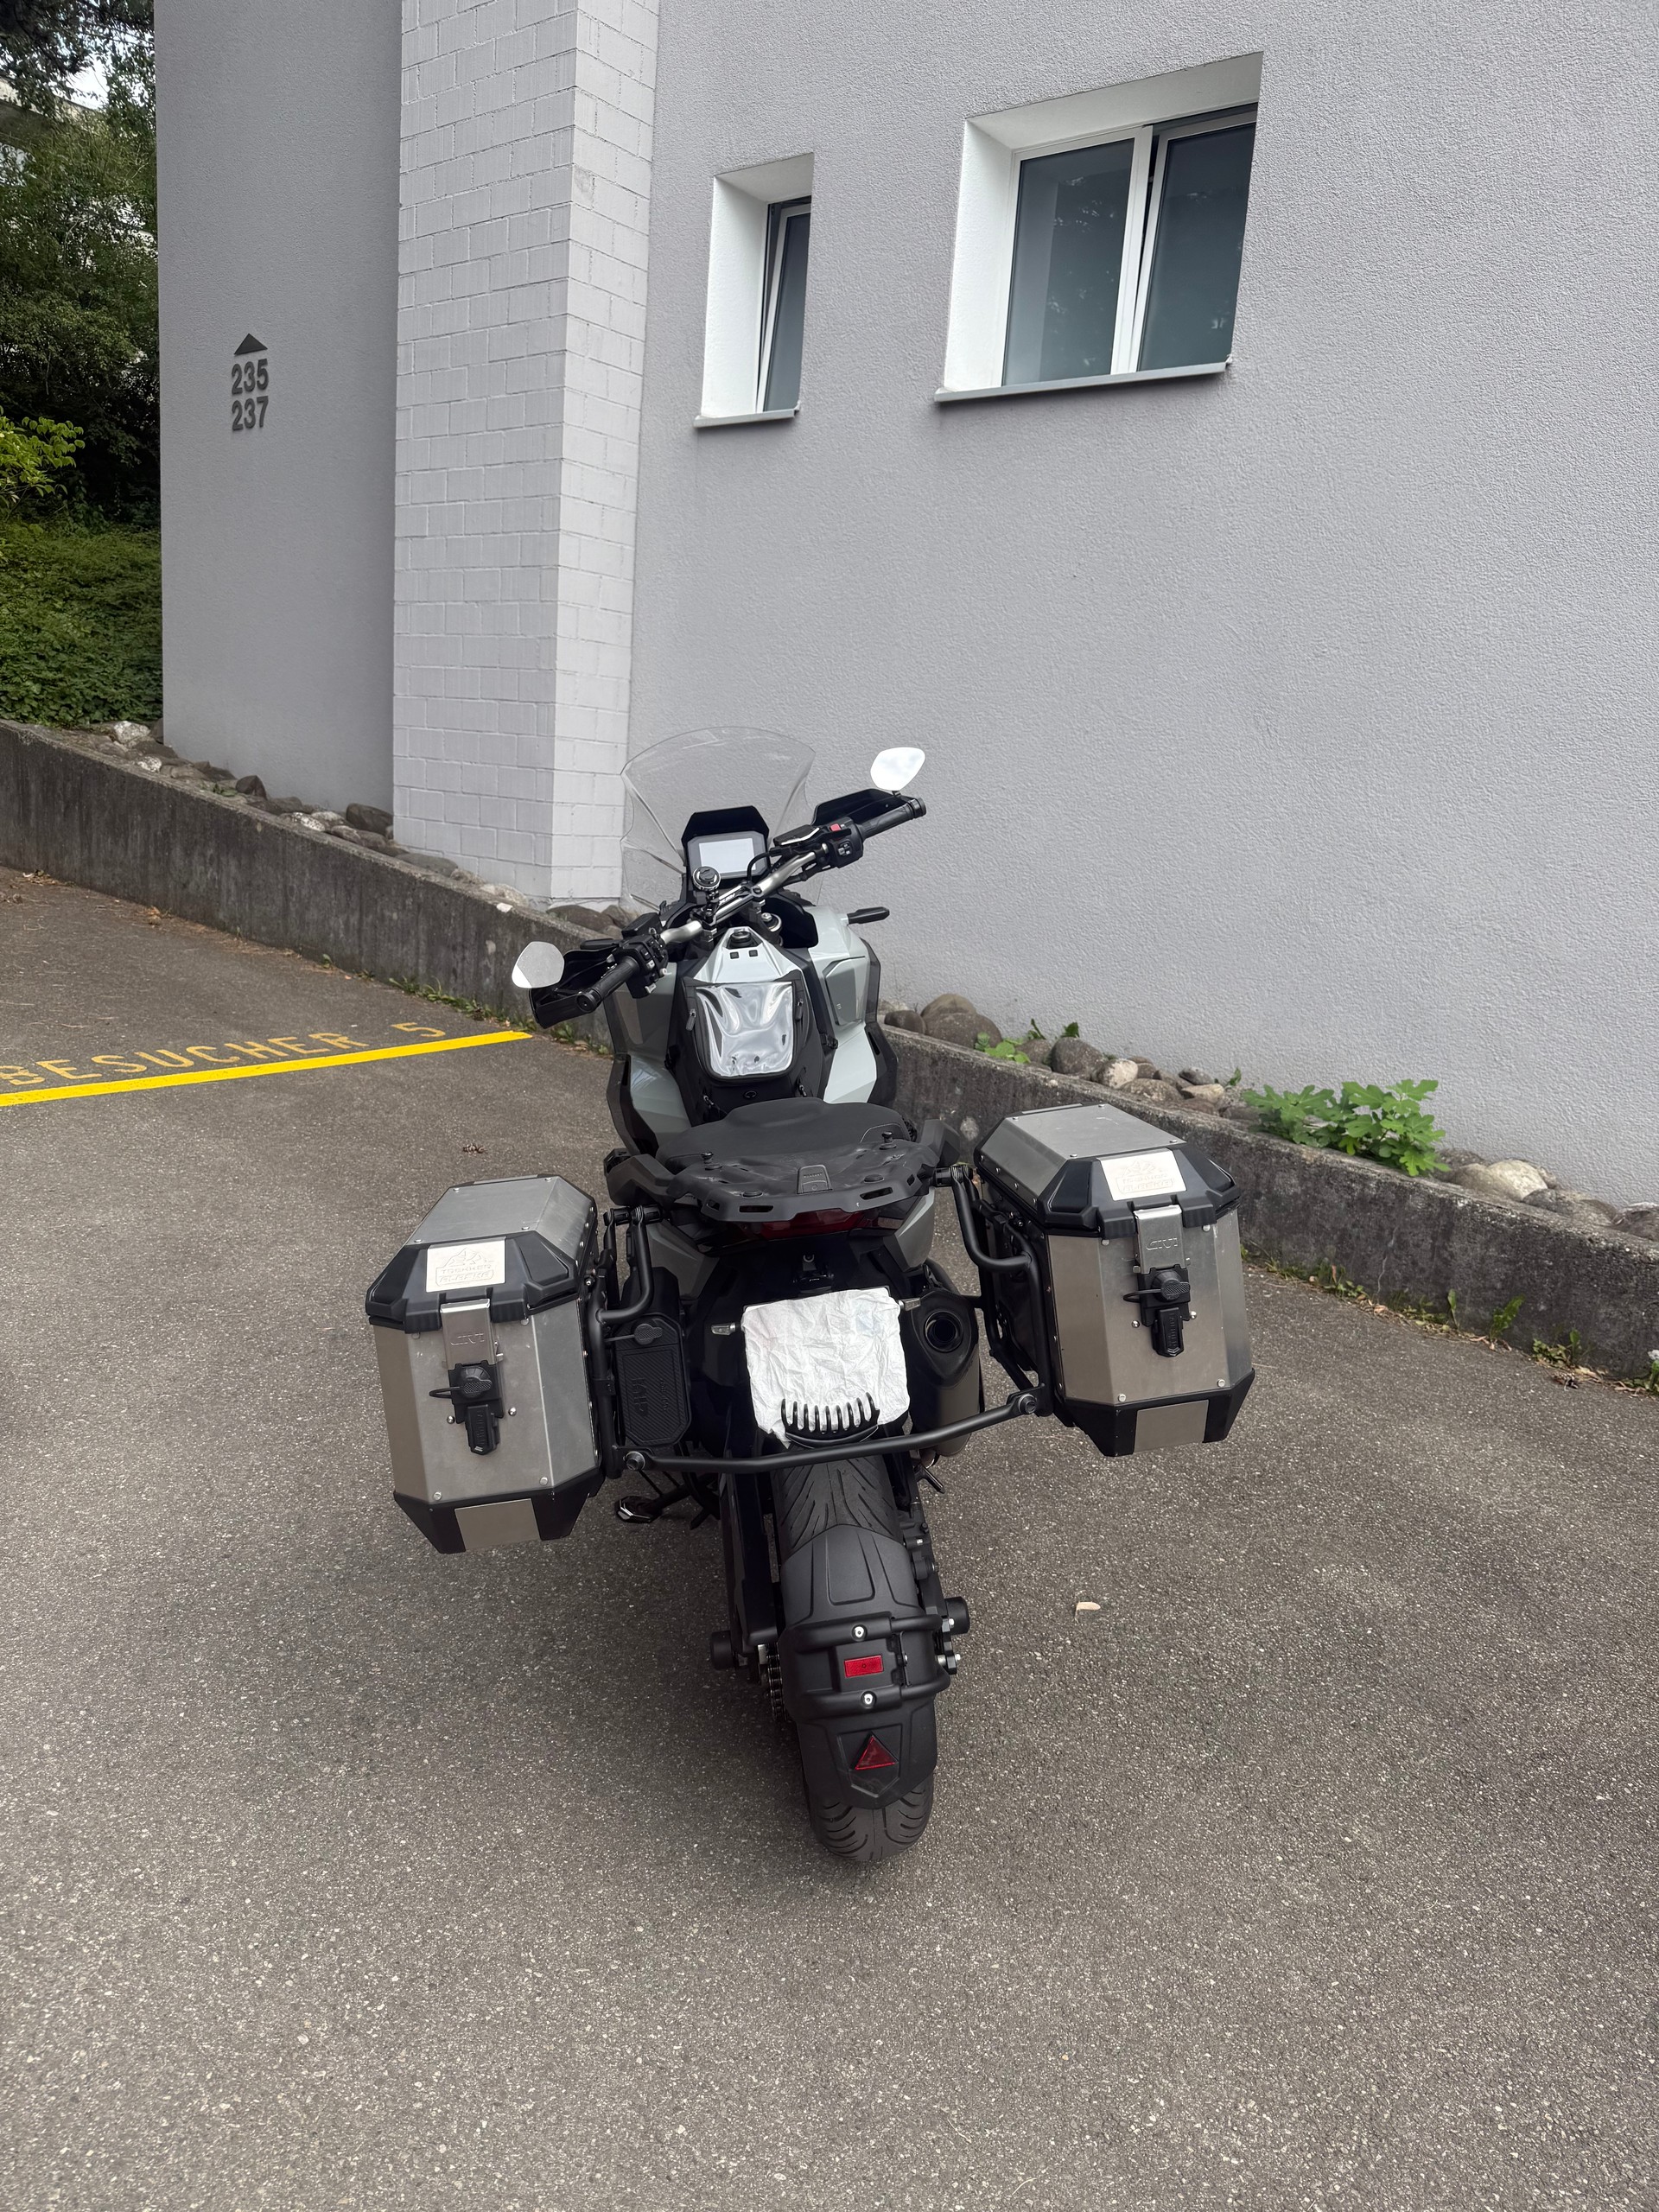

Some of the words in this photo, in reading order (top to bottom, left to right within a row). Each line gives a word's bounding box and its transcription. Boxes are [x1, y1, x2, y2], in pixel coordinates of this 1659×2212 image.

[232, 358, 269, 395] 235
[232, 396, 269, 431] 237
[0, 1032, 369, 1086] BESUCHER
[391, 1021, 446, 1038] 5
